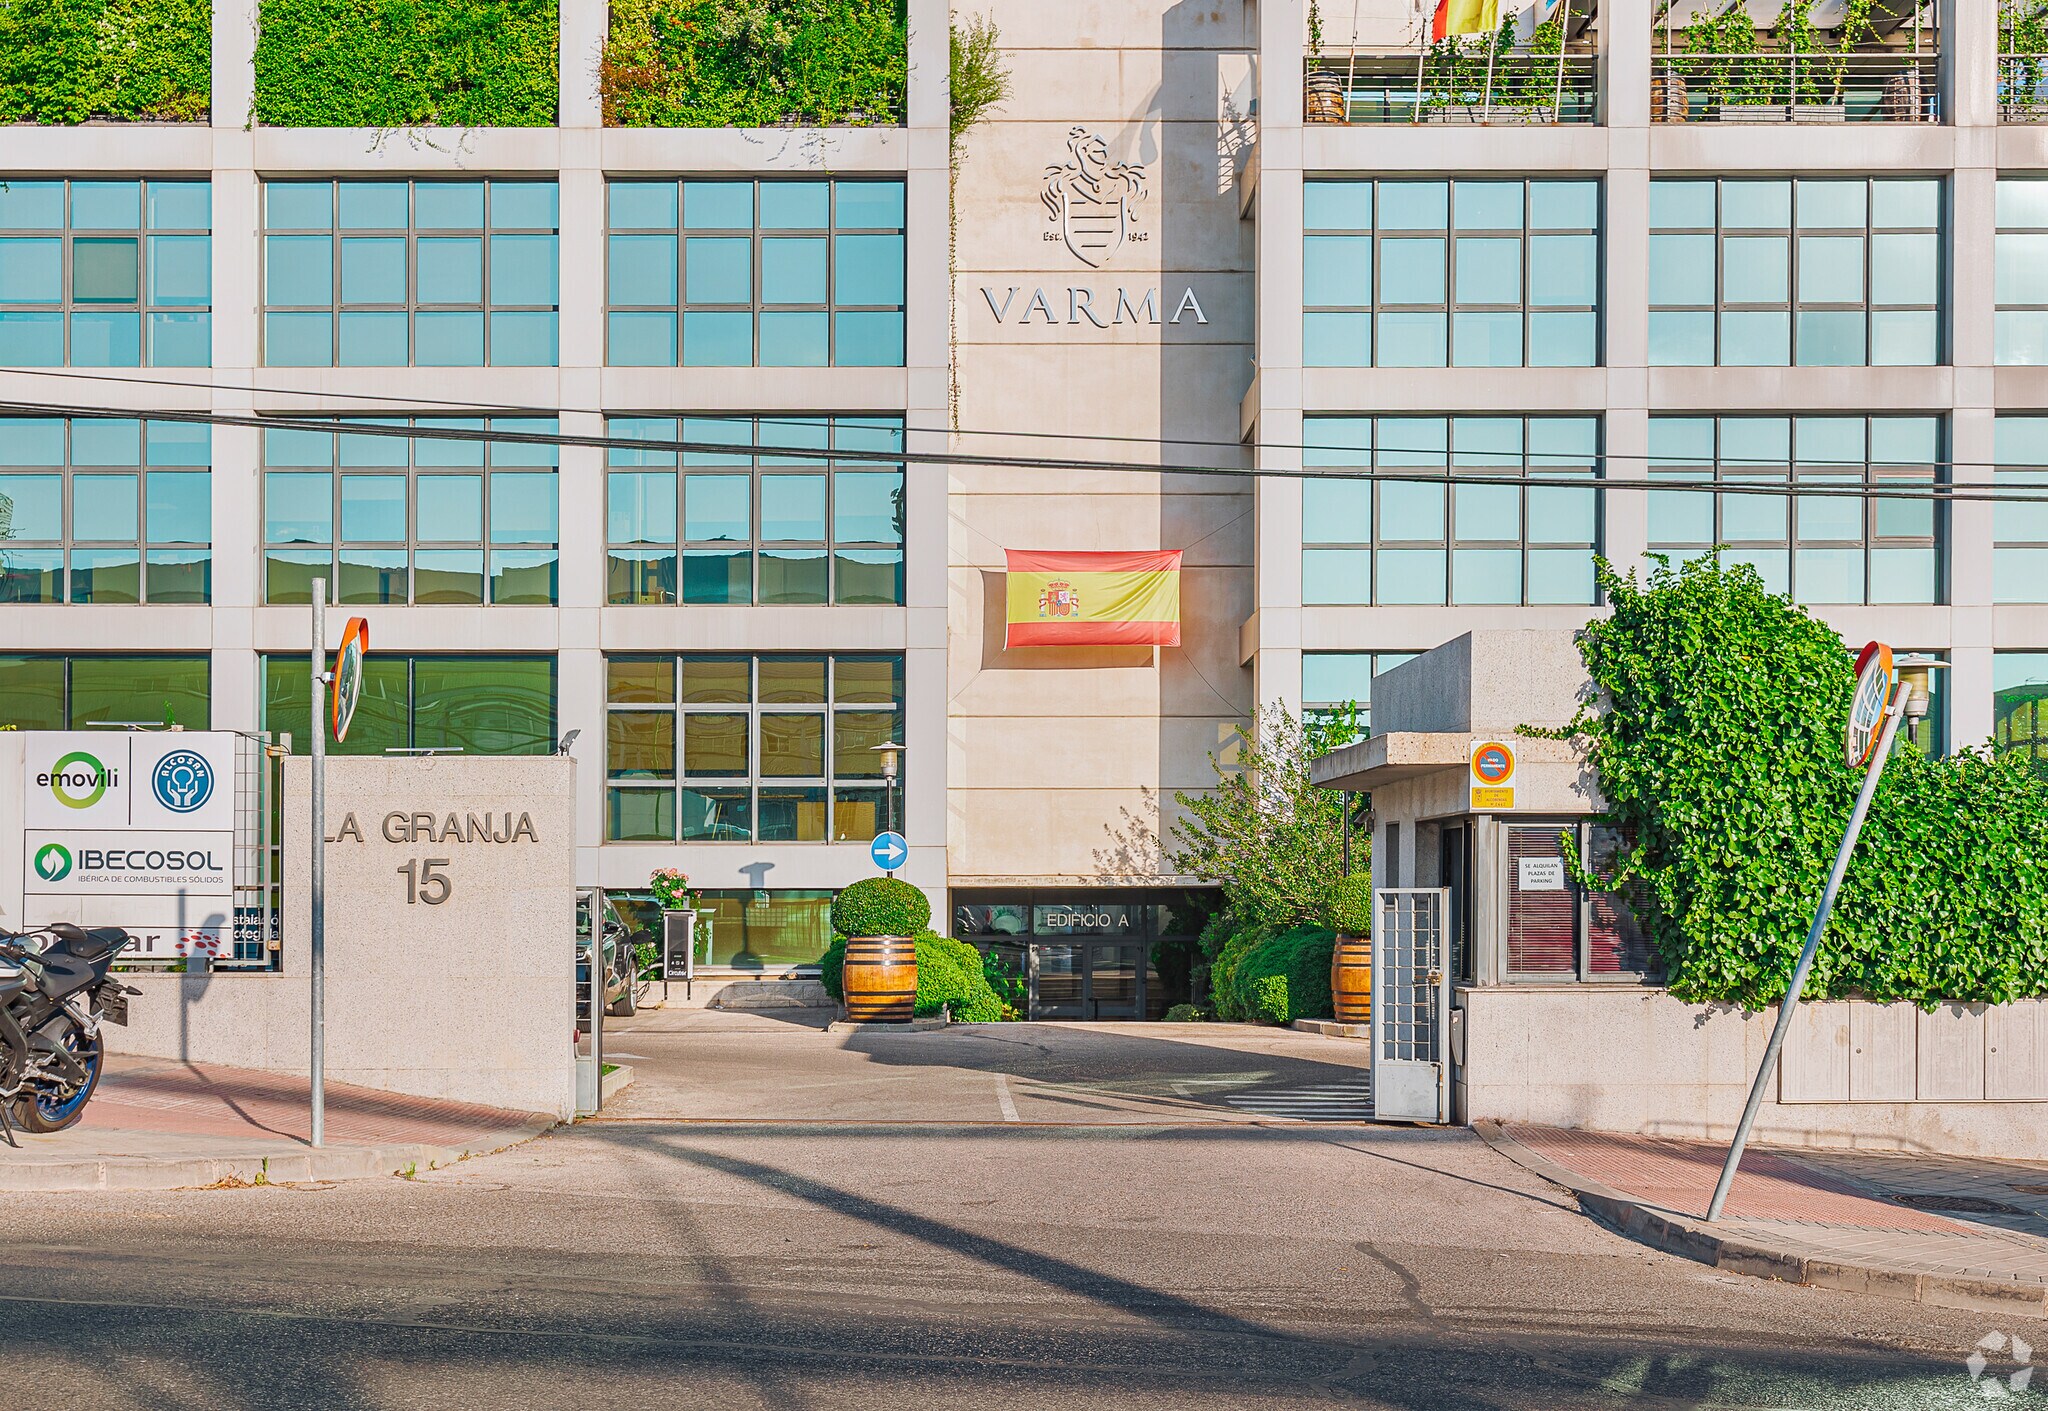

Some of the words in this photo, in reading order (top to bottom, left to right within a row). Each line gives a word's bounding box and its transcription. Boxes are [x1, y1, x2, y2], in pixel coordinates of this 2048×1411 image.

[1127, 231, 1149, 242] 1942
[980, 286, 1209, 328] VARMA
[161, 757, 205, 777] ALCOSAN
[37, 768, 118, 787] emovili
[324, 811, 364, 843] A
[382, 811, 539, 843] GRANJA
[78, 850, 223, 871] IBECOSOL
[78, 874, 109, 882] IBÉRICA
[124, 875, 187, 883] COMBUSTIBLES
[189, 874, 224, 883] SÓLIDOS
[397, 858, 452, 905] 15
[1047, 913, 1111, 927] EDIFICIO
[1117, 913, 1129, 927] A
